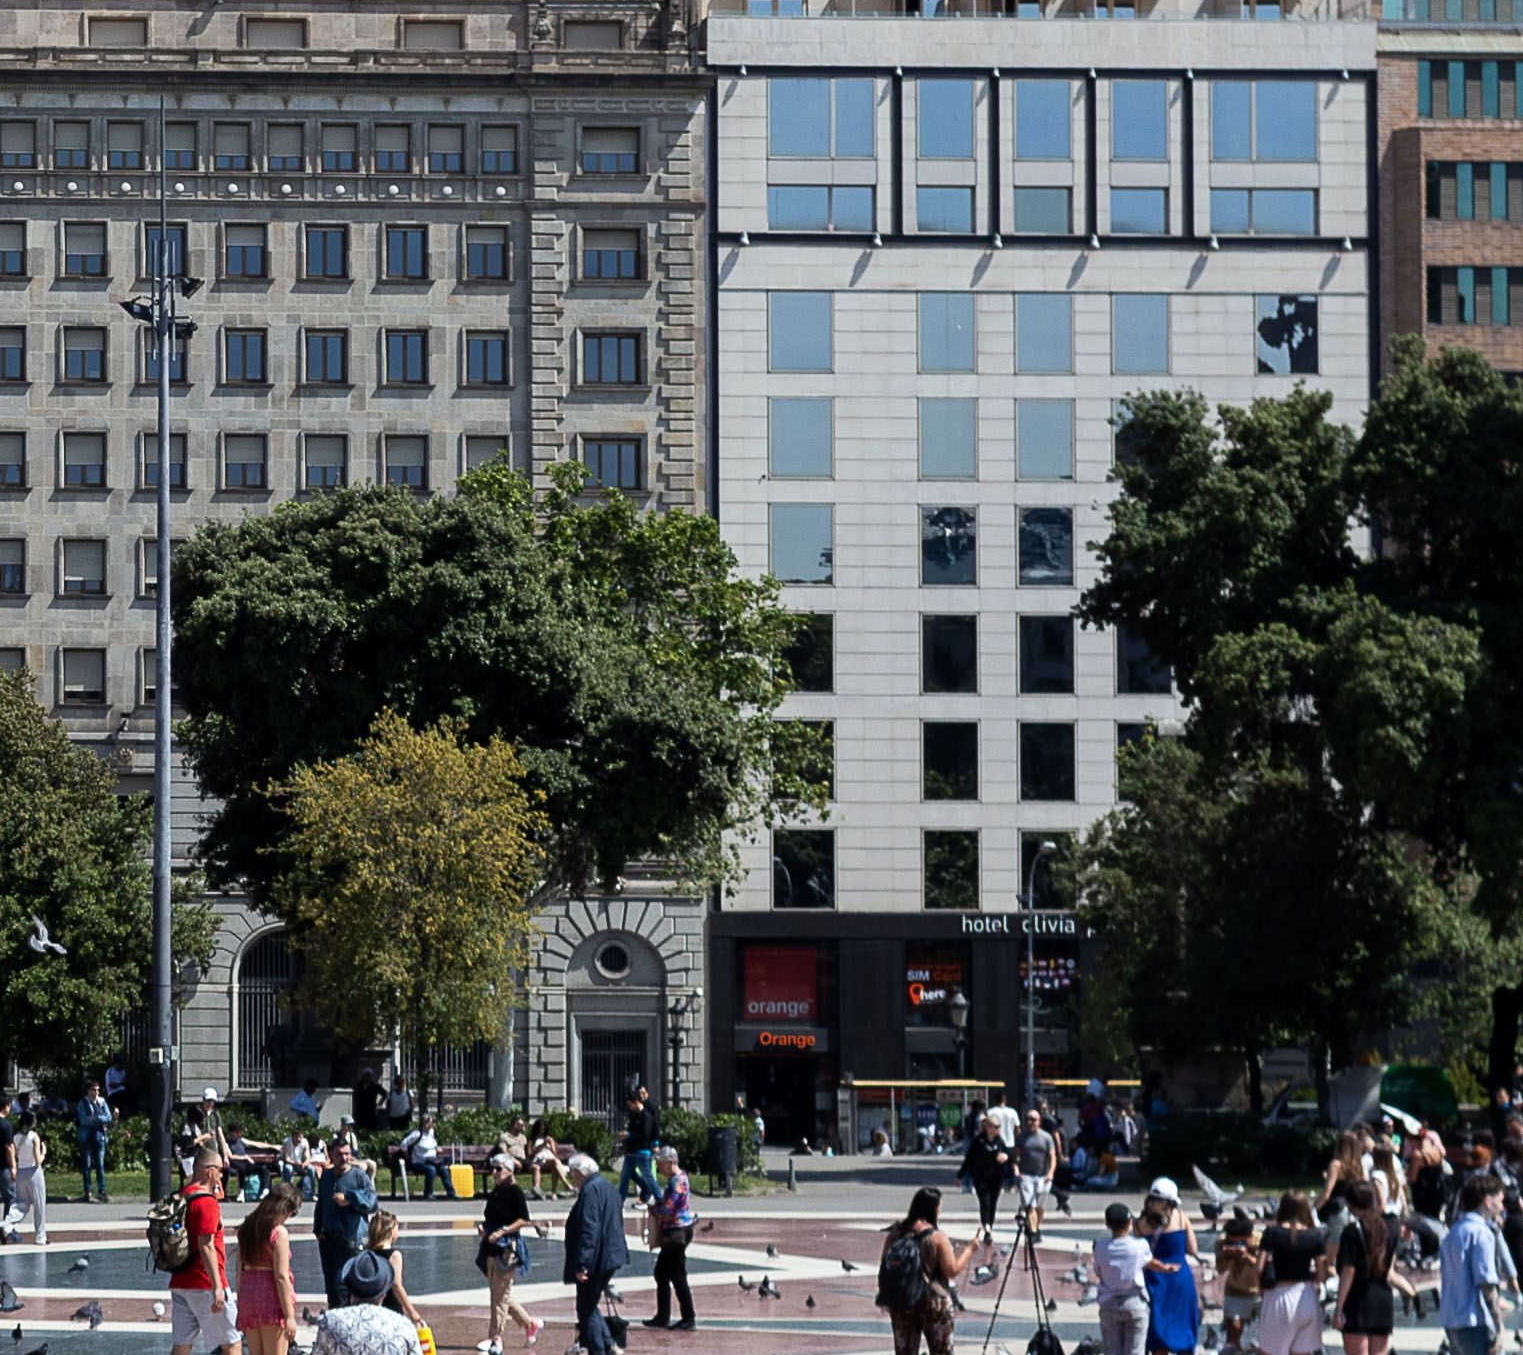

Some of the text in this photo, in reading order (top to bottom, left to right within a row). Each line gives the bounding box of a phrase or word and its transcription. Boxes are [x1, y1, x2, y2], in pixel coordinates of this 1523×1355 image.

[961, 914, 1009, 934] hotel
[1022, 914, 1076, 934] olivia
[907, 969, 930, 982] SIM
[919, 989, 947, 1001] here
[748, 1000, 810, 1018] orange
[759, 1031, 817, 1049] Orange
